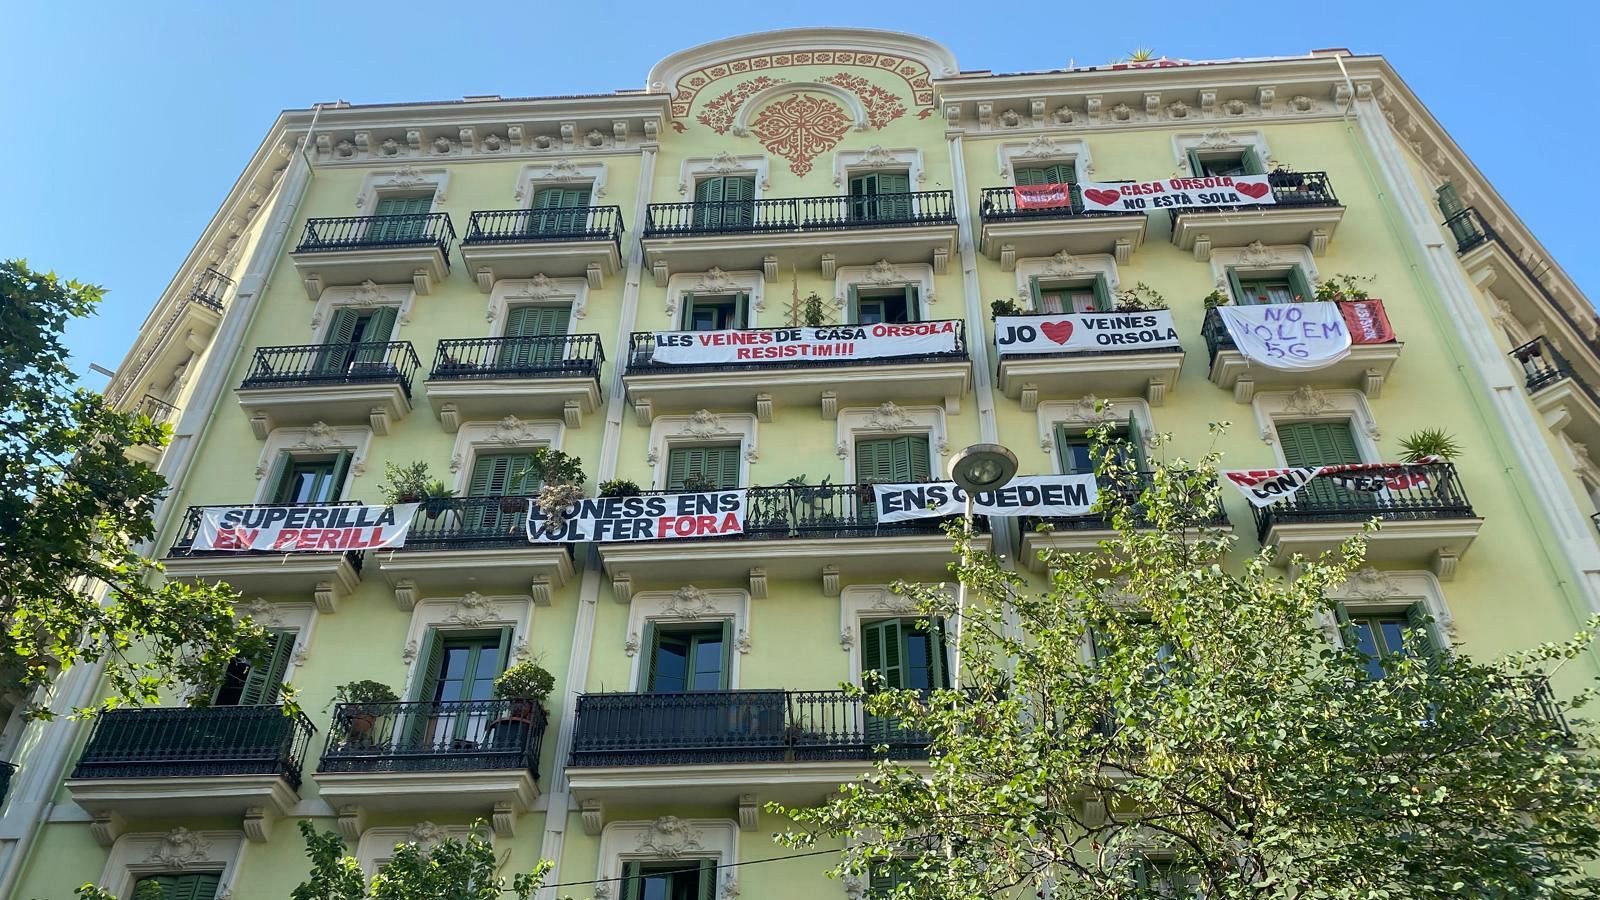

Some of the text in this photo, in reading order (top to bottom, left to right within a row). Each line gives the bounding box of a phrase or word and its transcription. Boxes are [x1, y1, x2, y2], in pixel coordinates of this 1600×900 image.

[1120, 176, 1235, 196] CASA ORSOLA
[1122, 192, 1241, 210] NO ESTÀ SOLA
[1265, 307, 1302, 322] NO
[656, 335, 693, 347] LES
[776, 329, 802, 342] DE
[814, 328, 867, 341] CASA
[872, 322, 954, 338] ORSOLA
[1000, 325, 1037, 345] JO
[1096, 328, 1178, 345] ORSOLA
[1235, 319, 1342, 341] VOLEM
[737, 343, 854, 360] RESISTIM!!!
[1264, 342, 1309, 358] 5G
[676, 493, 740, 516] ENS
[881, 486, 948, 515] ENS
[220, 507, 396, 529] SUPERILLA
[529, 513, 742, 541] VOL FER FORA
[212, 526, 387, 550] EN PERILL
